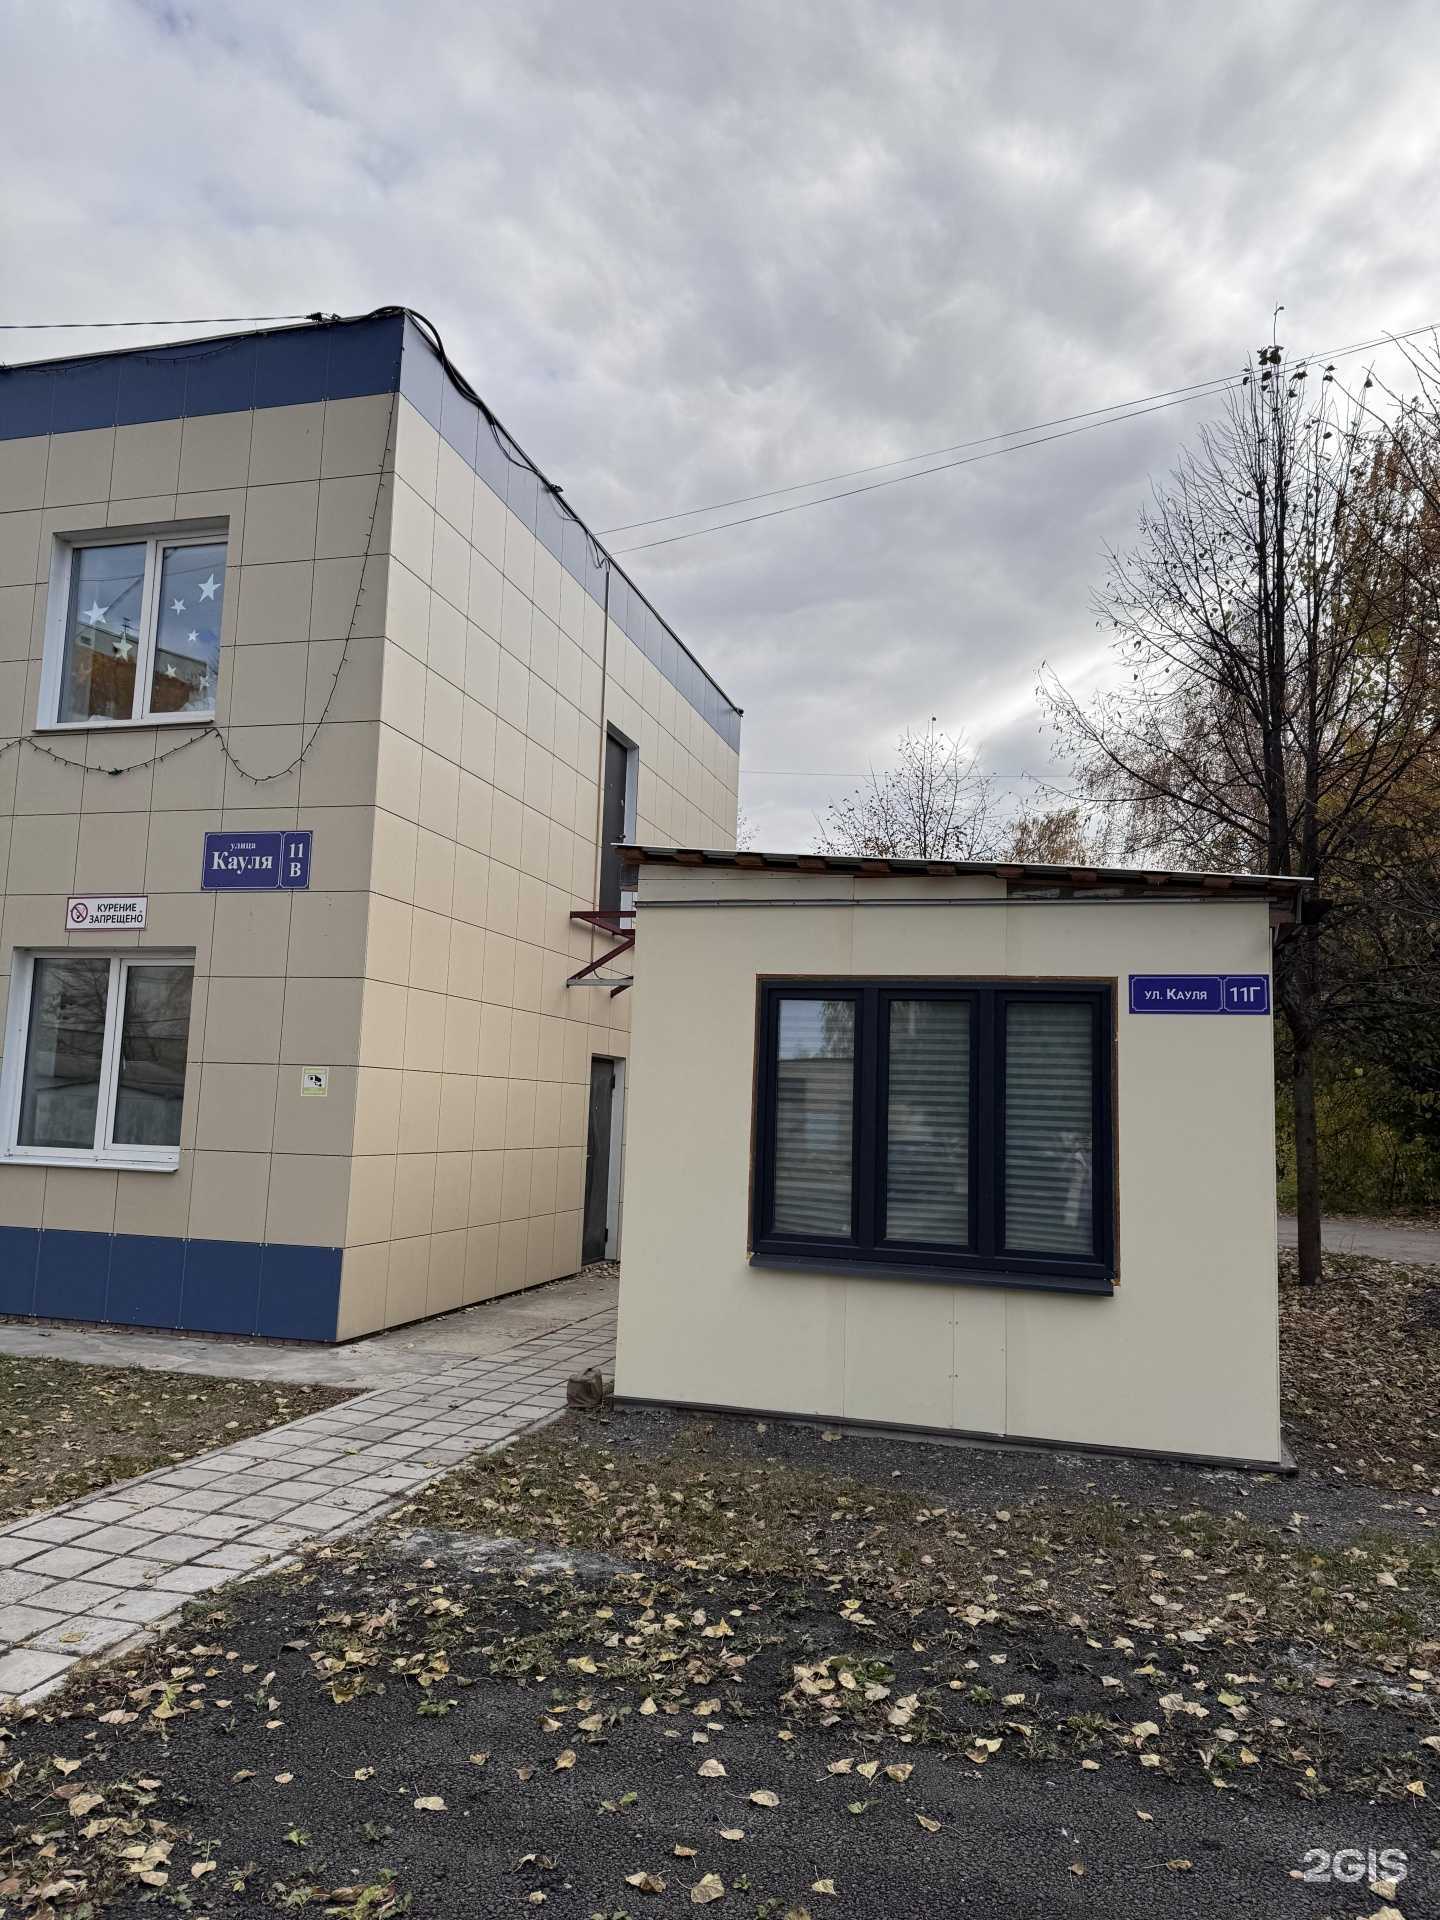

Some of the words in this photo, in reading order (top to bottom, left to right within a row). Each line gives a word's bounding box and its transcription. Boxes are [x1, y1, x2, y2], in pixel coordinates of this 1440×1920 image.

[230, 842, 256, 851] улица
[289, 843, 304, 858] 11
[209, 851, 273, 874] Кауля
[289, 862, 301, 877] В
[97, 903, 137, 912] КУРЕНИЕ
[88, 914, 143, 924] ЗАПРЕЩЕНО
[1230, 986, 1261, 1002] 11Г
